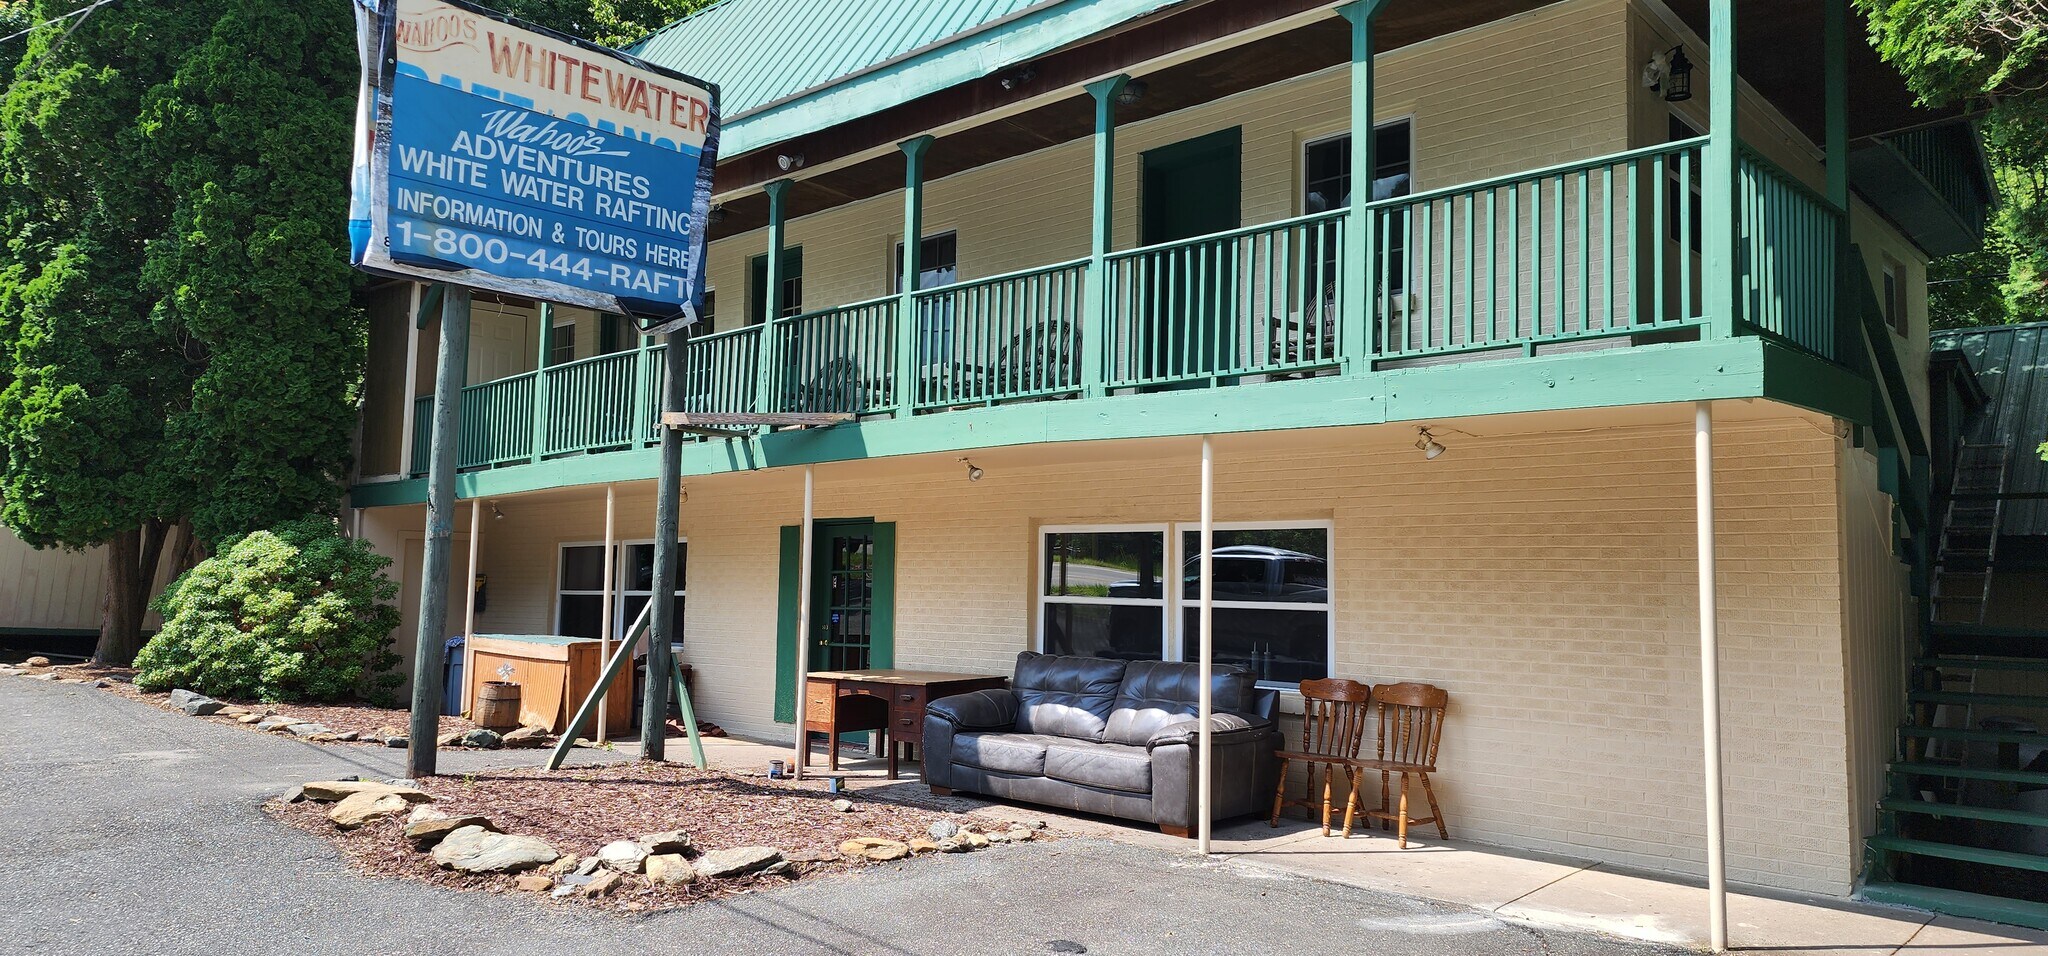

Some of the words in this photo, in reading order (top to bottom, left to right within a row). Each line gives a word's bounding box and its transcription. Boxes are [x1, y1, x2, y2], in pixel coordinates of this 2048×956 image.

[487, 31, 709, 135] WHITEWATER
[451, 130, 650, 199] ADVENTURES
[481, 109, 631, 158] Wahoo's
[397, 187, 543, 239] INFORMATION
[551, 222, 565, 244] &
[575, 226, 638, 259] TOURS
[645, 242, 689, 270] HERE
[398, 144, 488, 189] WHITE
[501, 169, 584, 212] WATER
[595, 192, 691, 236] RAFTING
[396, 221, 689, 299] 1-800-444-RAFT
